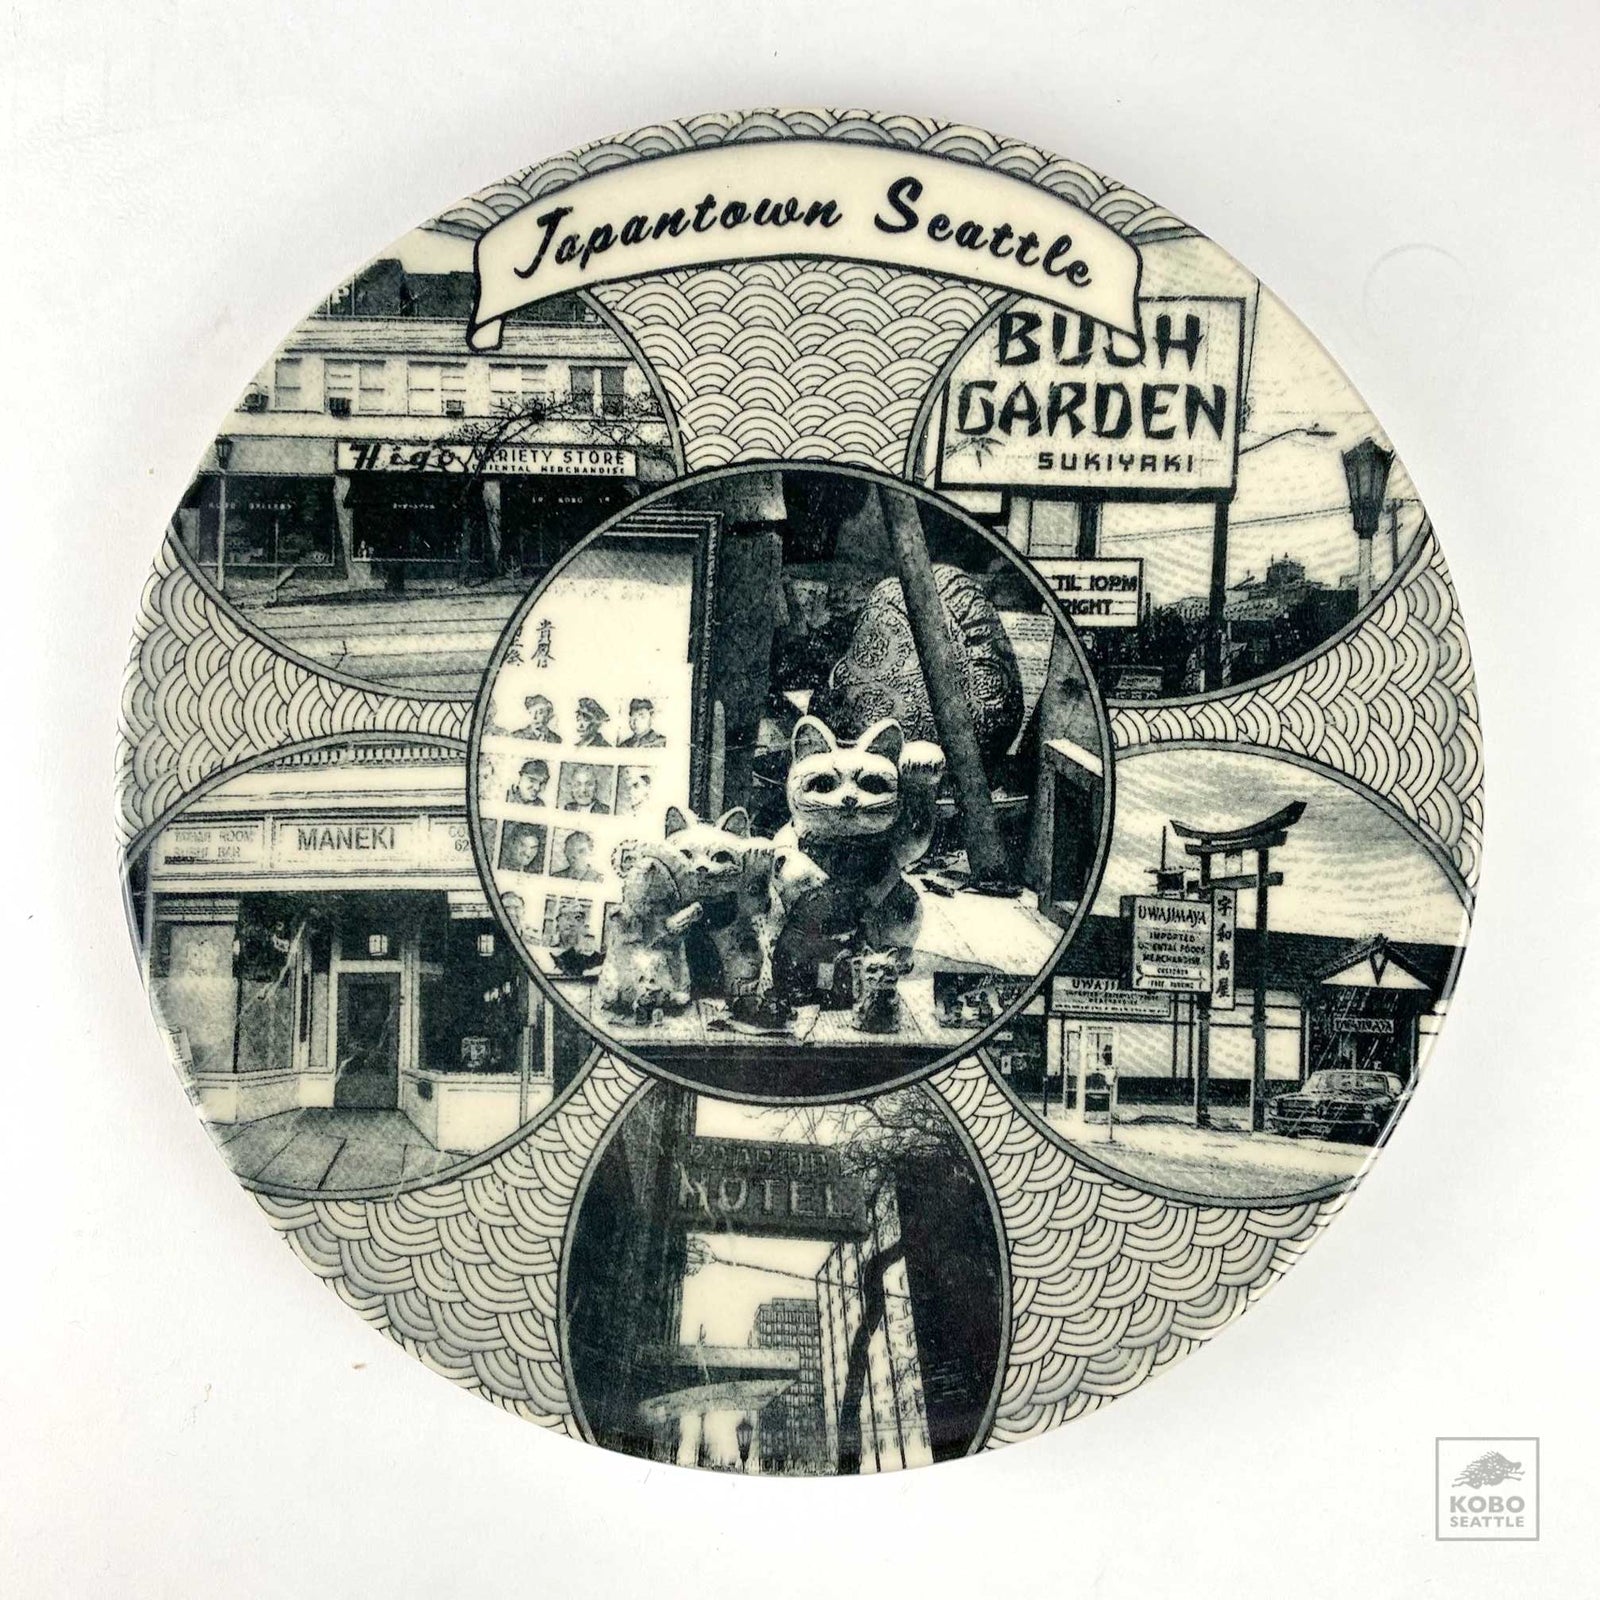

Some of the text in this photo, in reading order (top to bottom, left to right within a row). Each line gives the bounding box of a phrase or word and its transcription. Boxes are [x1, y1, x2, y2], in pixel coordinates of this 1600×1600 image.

[513, 175, 1092, 288] Japantown Seattle
[954, 380, 1227, 441] GARDEN
[563, 450, 625, 465] STORE
[1037, 451, 1193, 473] SUKIYAKI
[298, 826, 395, 851] MANEKI
[1138, 904, 1207, 928] UWAJIMAYA
